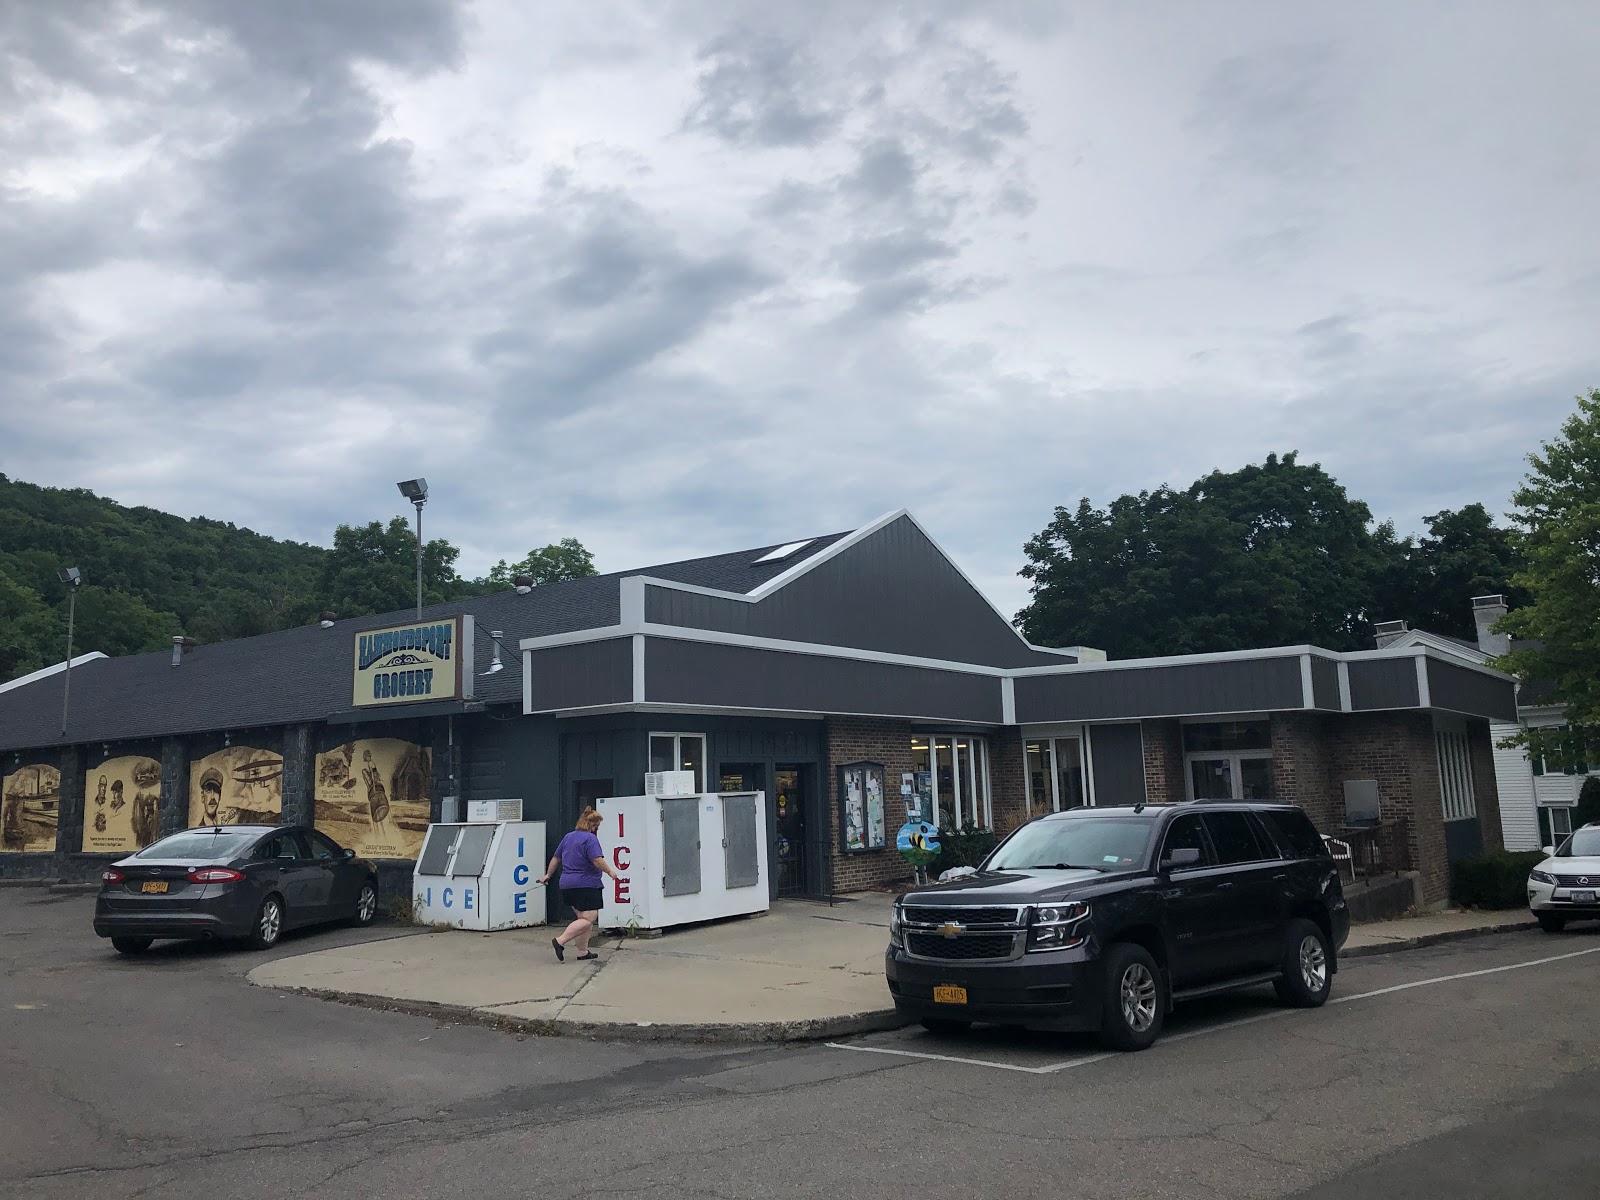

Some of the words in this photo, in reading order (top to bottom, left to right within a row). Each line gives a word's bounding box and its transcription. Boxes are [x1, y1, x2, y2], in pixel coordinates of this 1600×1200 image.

[358, 623, 452, 670] HAMMONDSPORT
[373, 668, 433, 699] GROCERY
[513, 837, 529, 914] ICE
[613, 813, 631, 904] ICE
[426, 887, 474, 910] ICE
